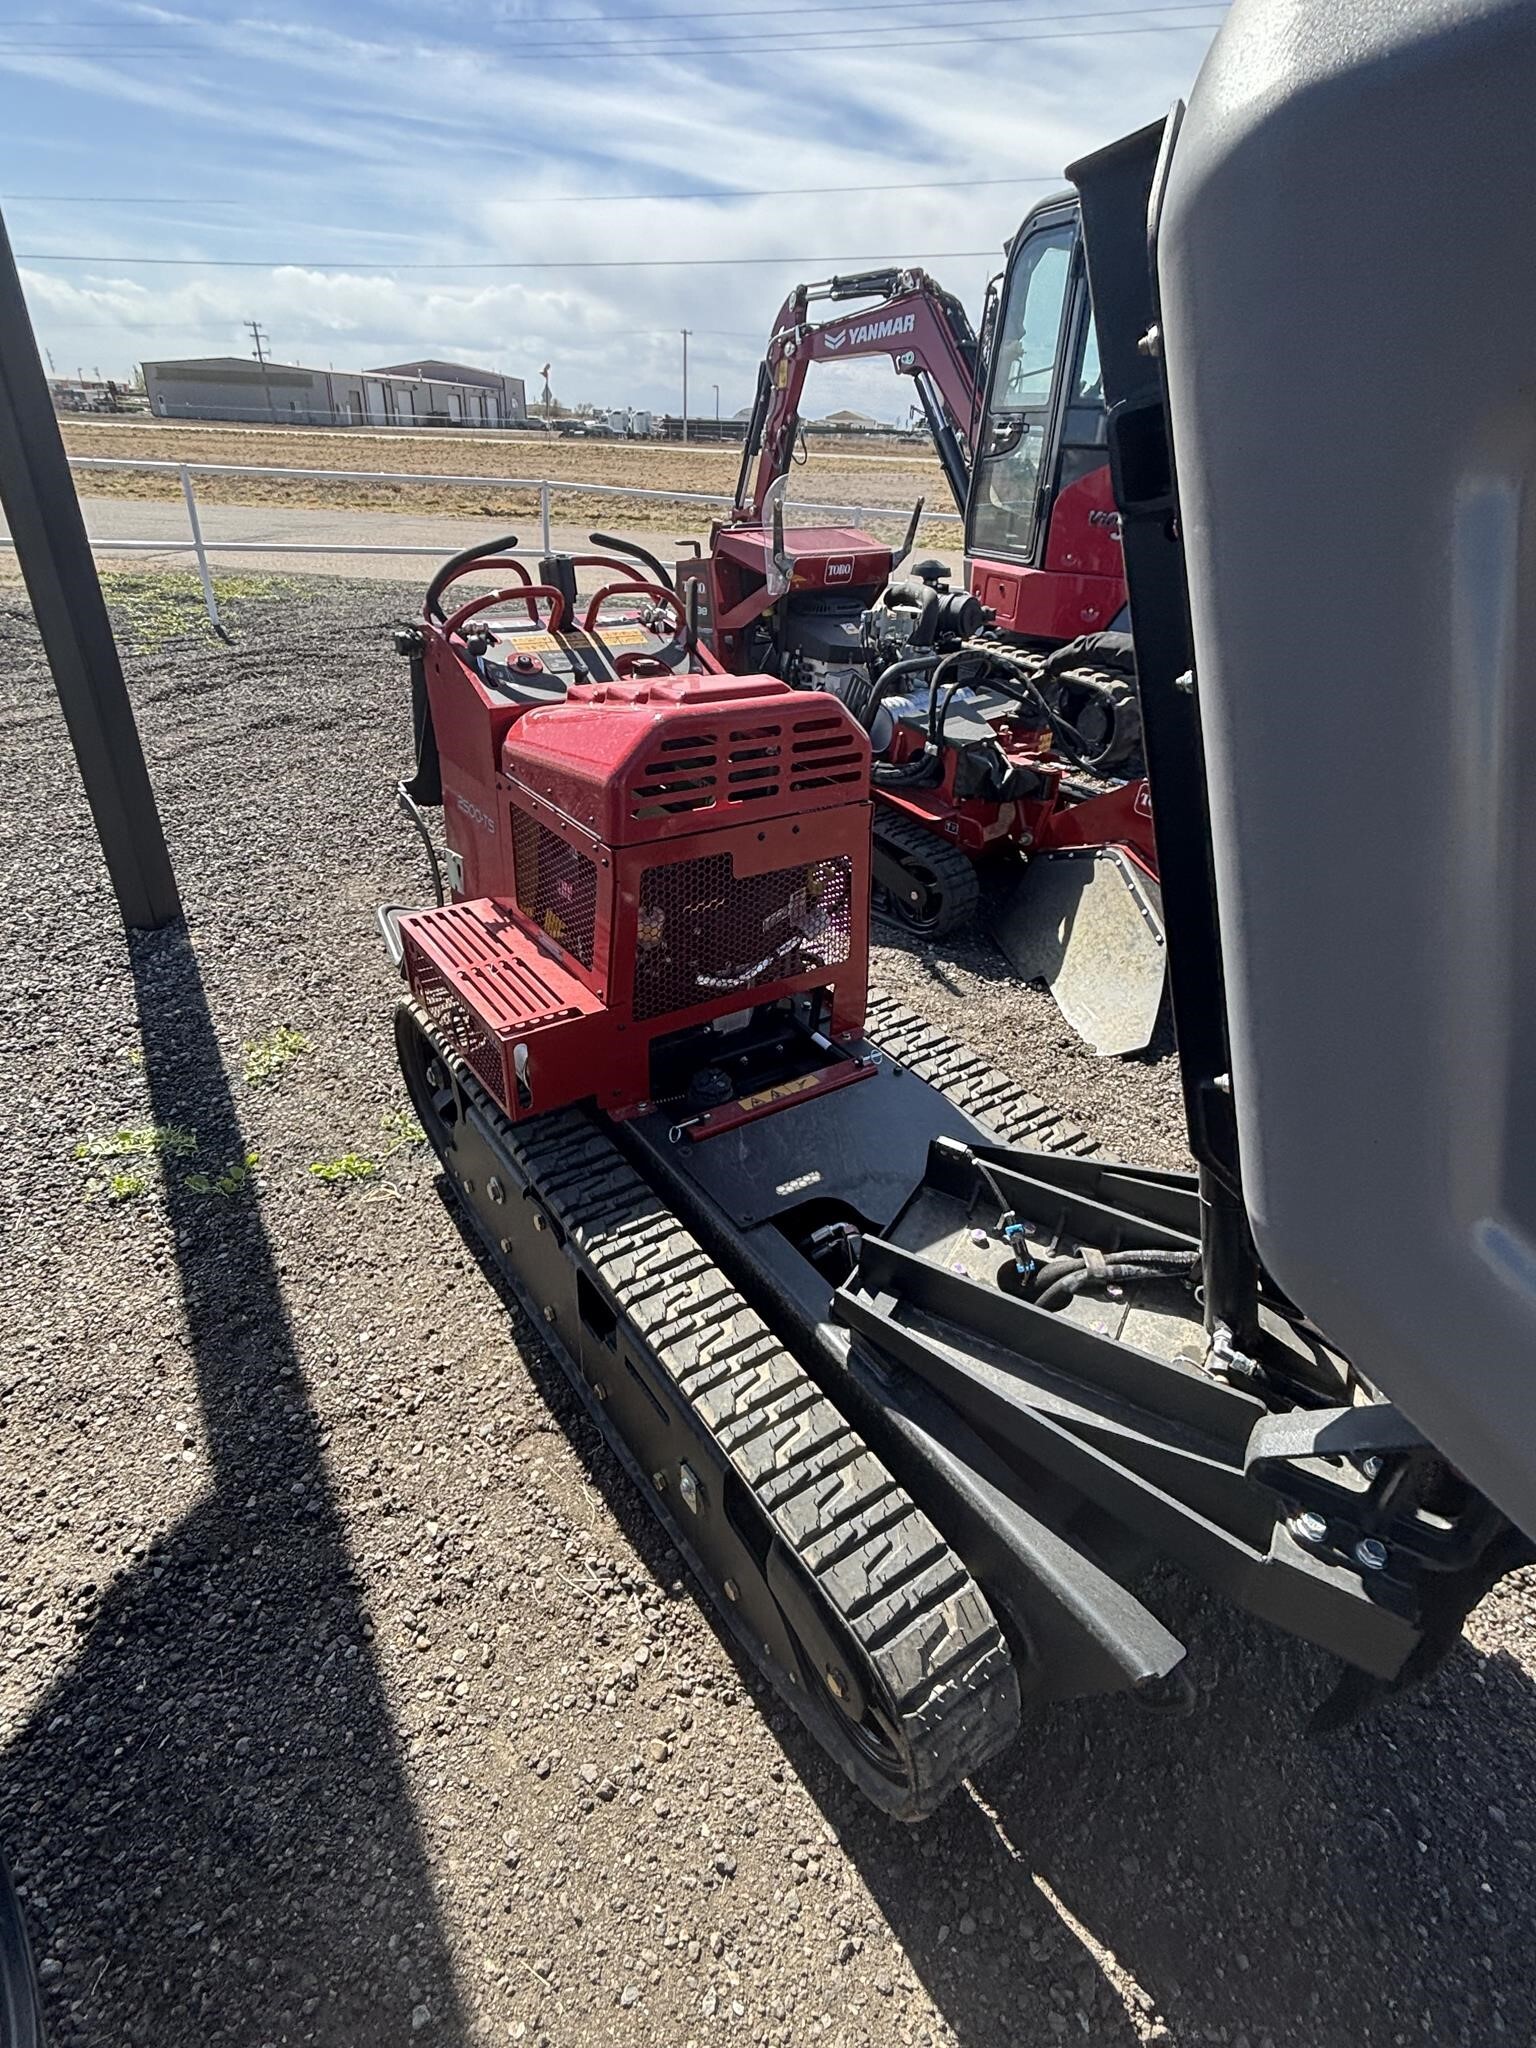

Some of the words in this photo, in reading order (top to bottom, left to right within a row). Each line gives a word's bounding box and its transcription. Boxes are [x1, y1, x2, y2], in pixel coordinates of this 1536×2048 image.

[848, 313, 915, 345] YANMAR
[828, 563, 851, 576] TORO
[681, 580, 706, 594] TO
